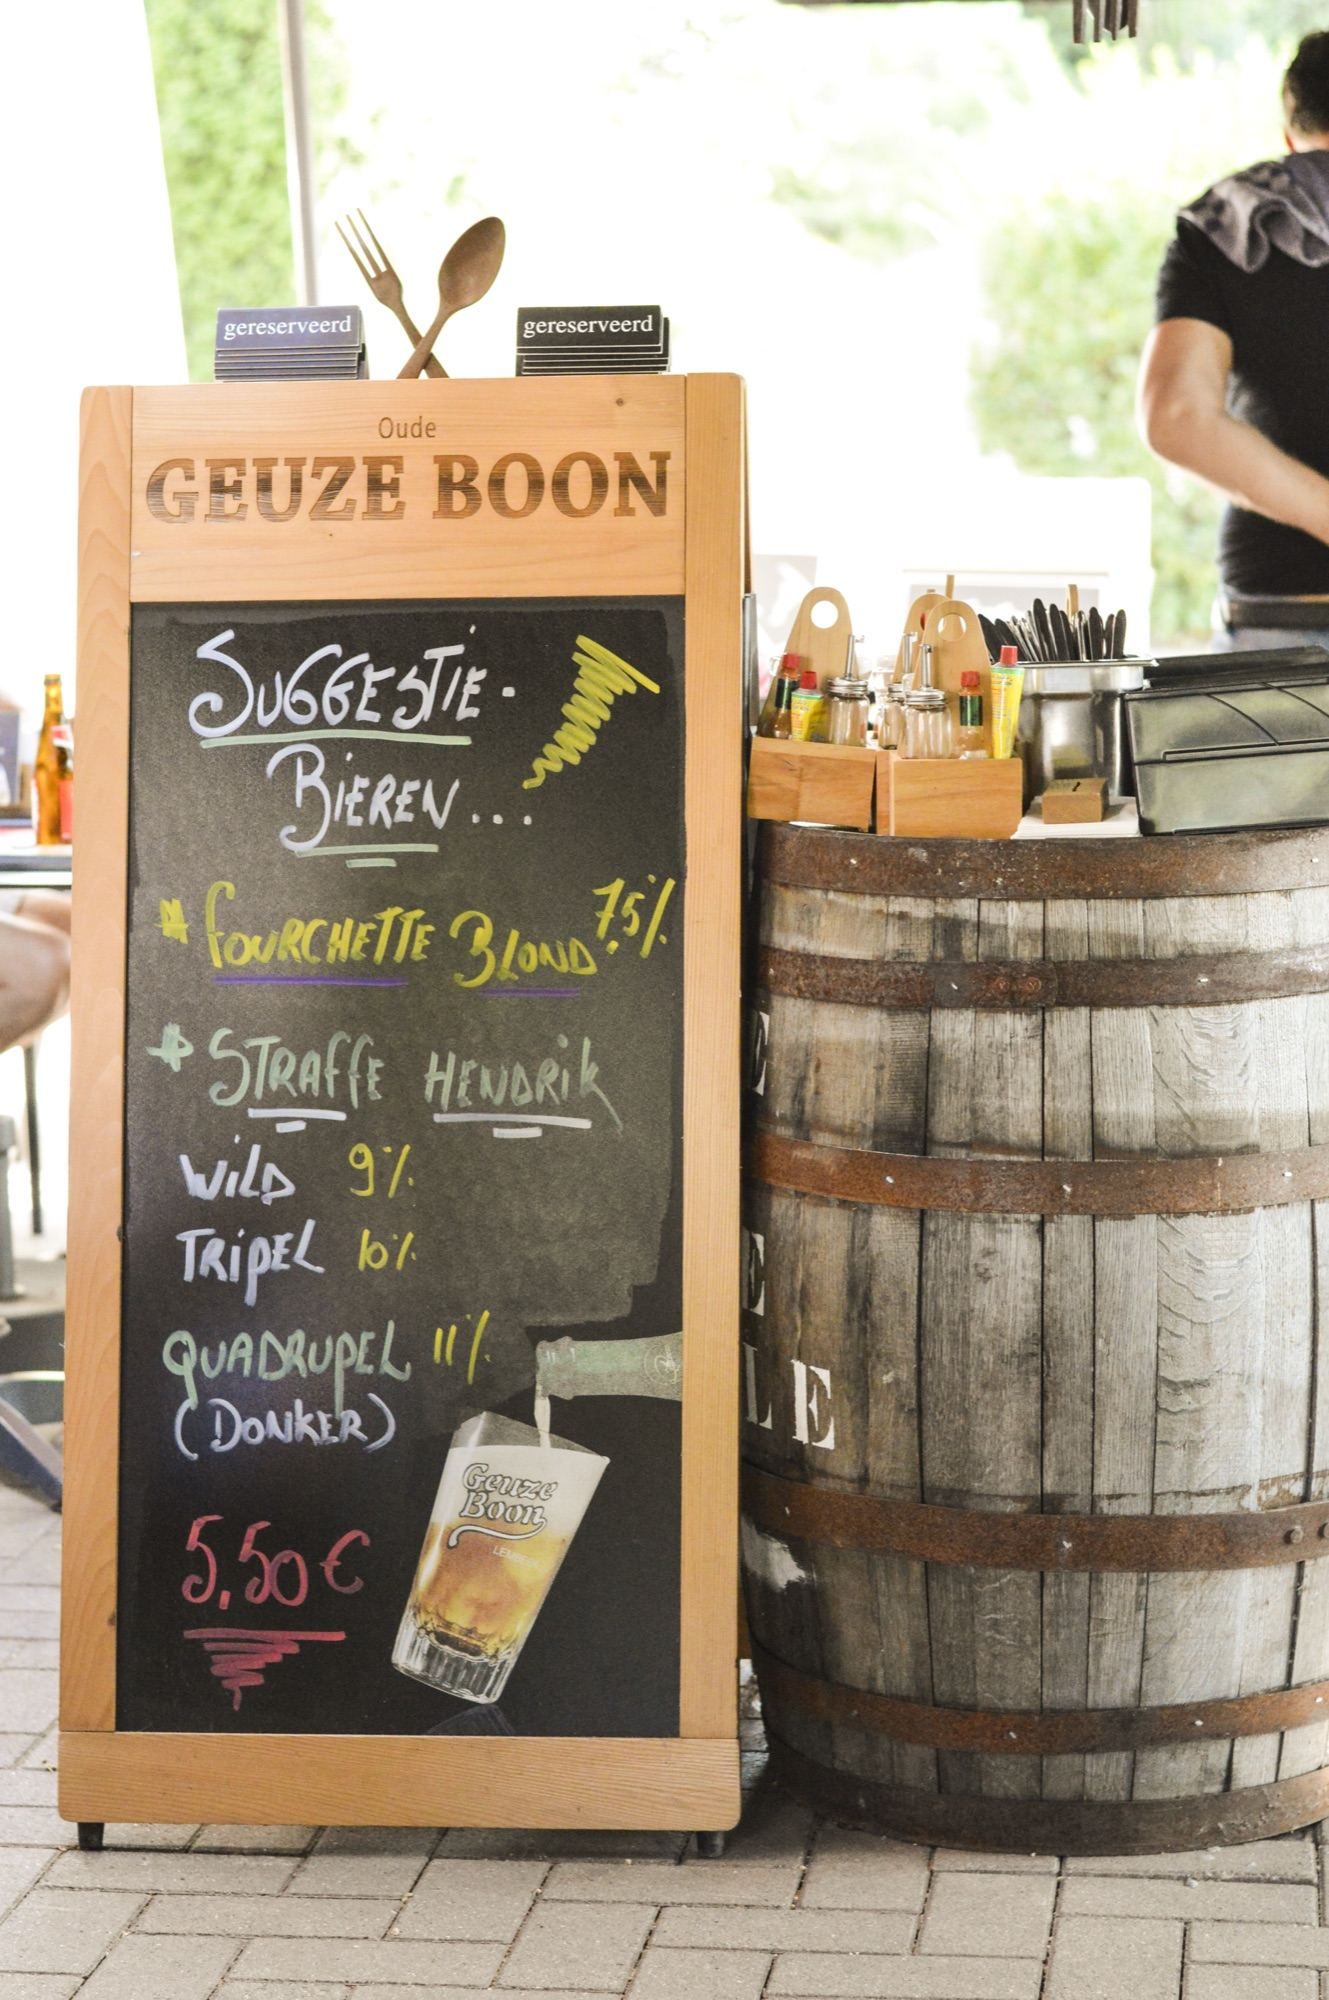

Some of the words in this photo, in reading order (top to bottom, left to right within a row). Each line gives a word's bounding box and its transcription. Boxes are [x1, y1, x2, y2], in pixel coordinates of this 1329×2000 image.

[223, 315, 352, 340] gereserveerd
[523, 314, 653, 339] gereserveerd
[378, 416, 436, 439] Oude
[146, 455, 407, 524] GEUZE
[432, 451, 671, 519] BOON
[349, 1143, 415, 1199] 9%
[357, 1228, 417, 1272] 10%
[162, 1319, 412, 1419] QUADRUPEL
[462, 1462, 559, 1502] Geuze
[458, 1489, 548, 1526] Boon
